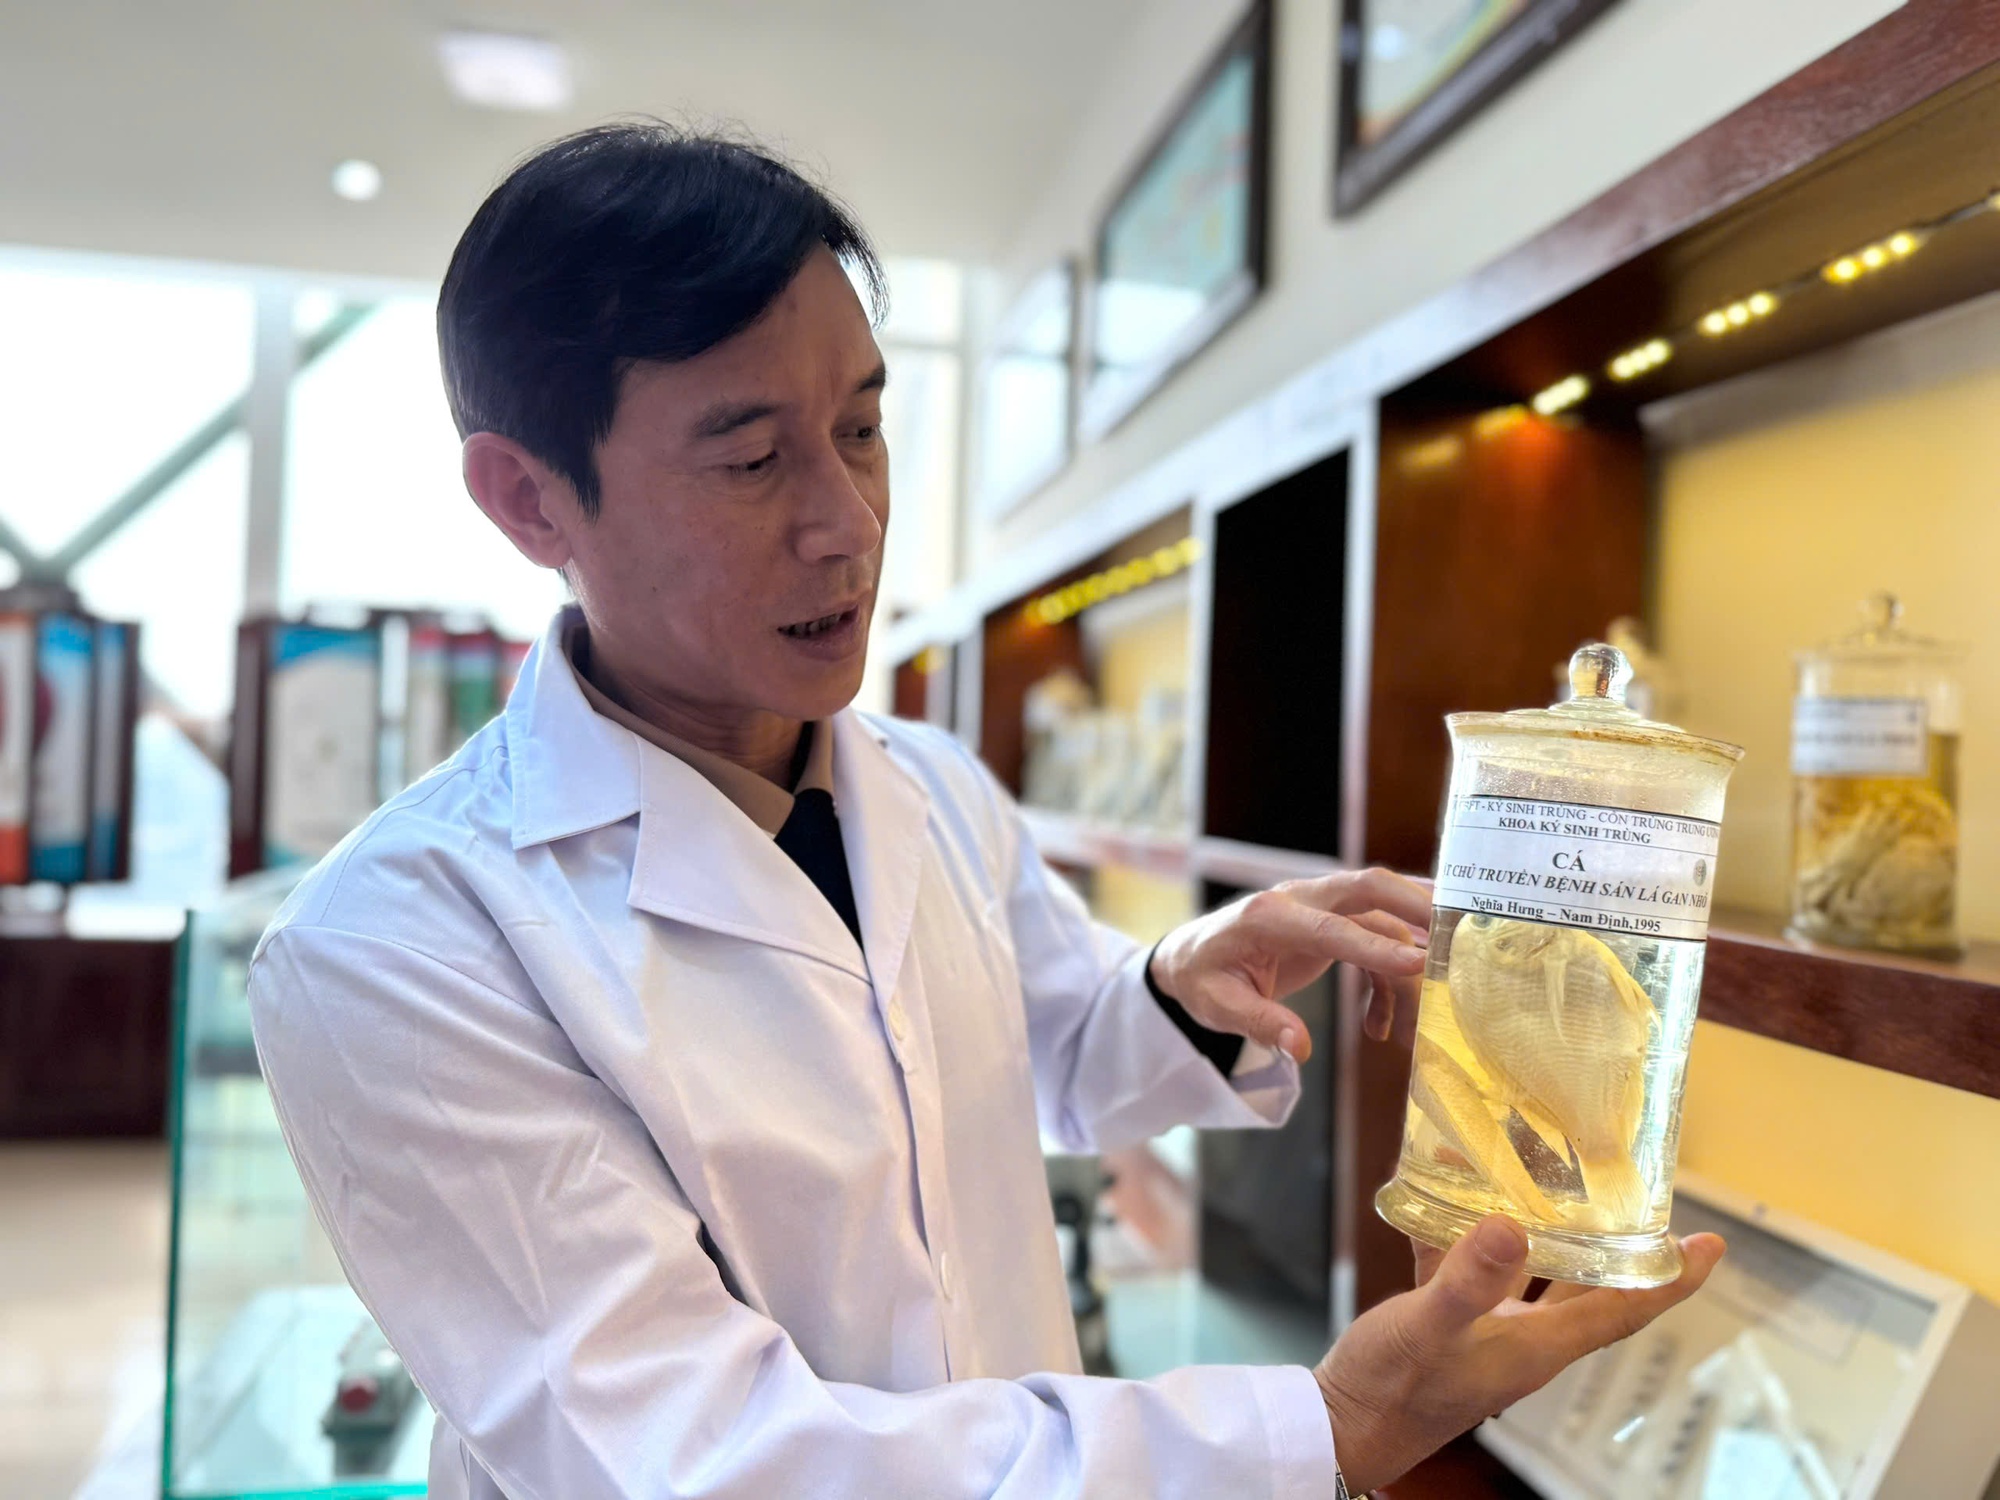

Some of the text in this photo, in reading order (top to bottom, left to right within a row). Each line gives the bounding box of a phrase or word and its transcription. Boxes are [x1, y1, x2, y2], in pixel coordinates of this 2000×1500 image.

[1487, 798, 1503, 812] KÝ
[1505, 802, 1535, 815] SINH
[1538, 804, 1587, 820] TRÙNG
[1598, 810, 1629, 825] CÔN
[1631, 814, 1674, 832] TRÙNG
[1675, 821, 1705, 837] TRUNG
[1498, 817, 1651, 844] KHOA KÝ SINH TRÙNG
[1552, 849, 1586, 872] CÁ
[1452, 863, 1476, 879] CHỦ
[1544, 875, 1597, 893] BỆNH
[1599, 880, 1636, 899] SÁN
[1637, 885, 1660, 902] LÁ
[1661, 890, 1689, 905] GAN
[1471, 896, 1503, 912] Nghĩa
[1508, 901, 1544, 919] Hưng
[1560, 908, 1592, 923] Nam
